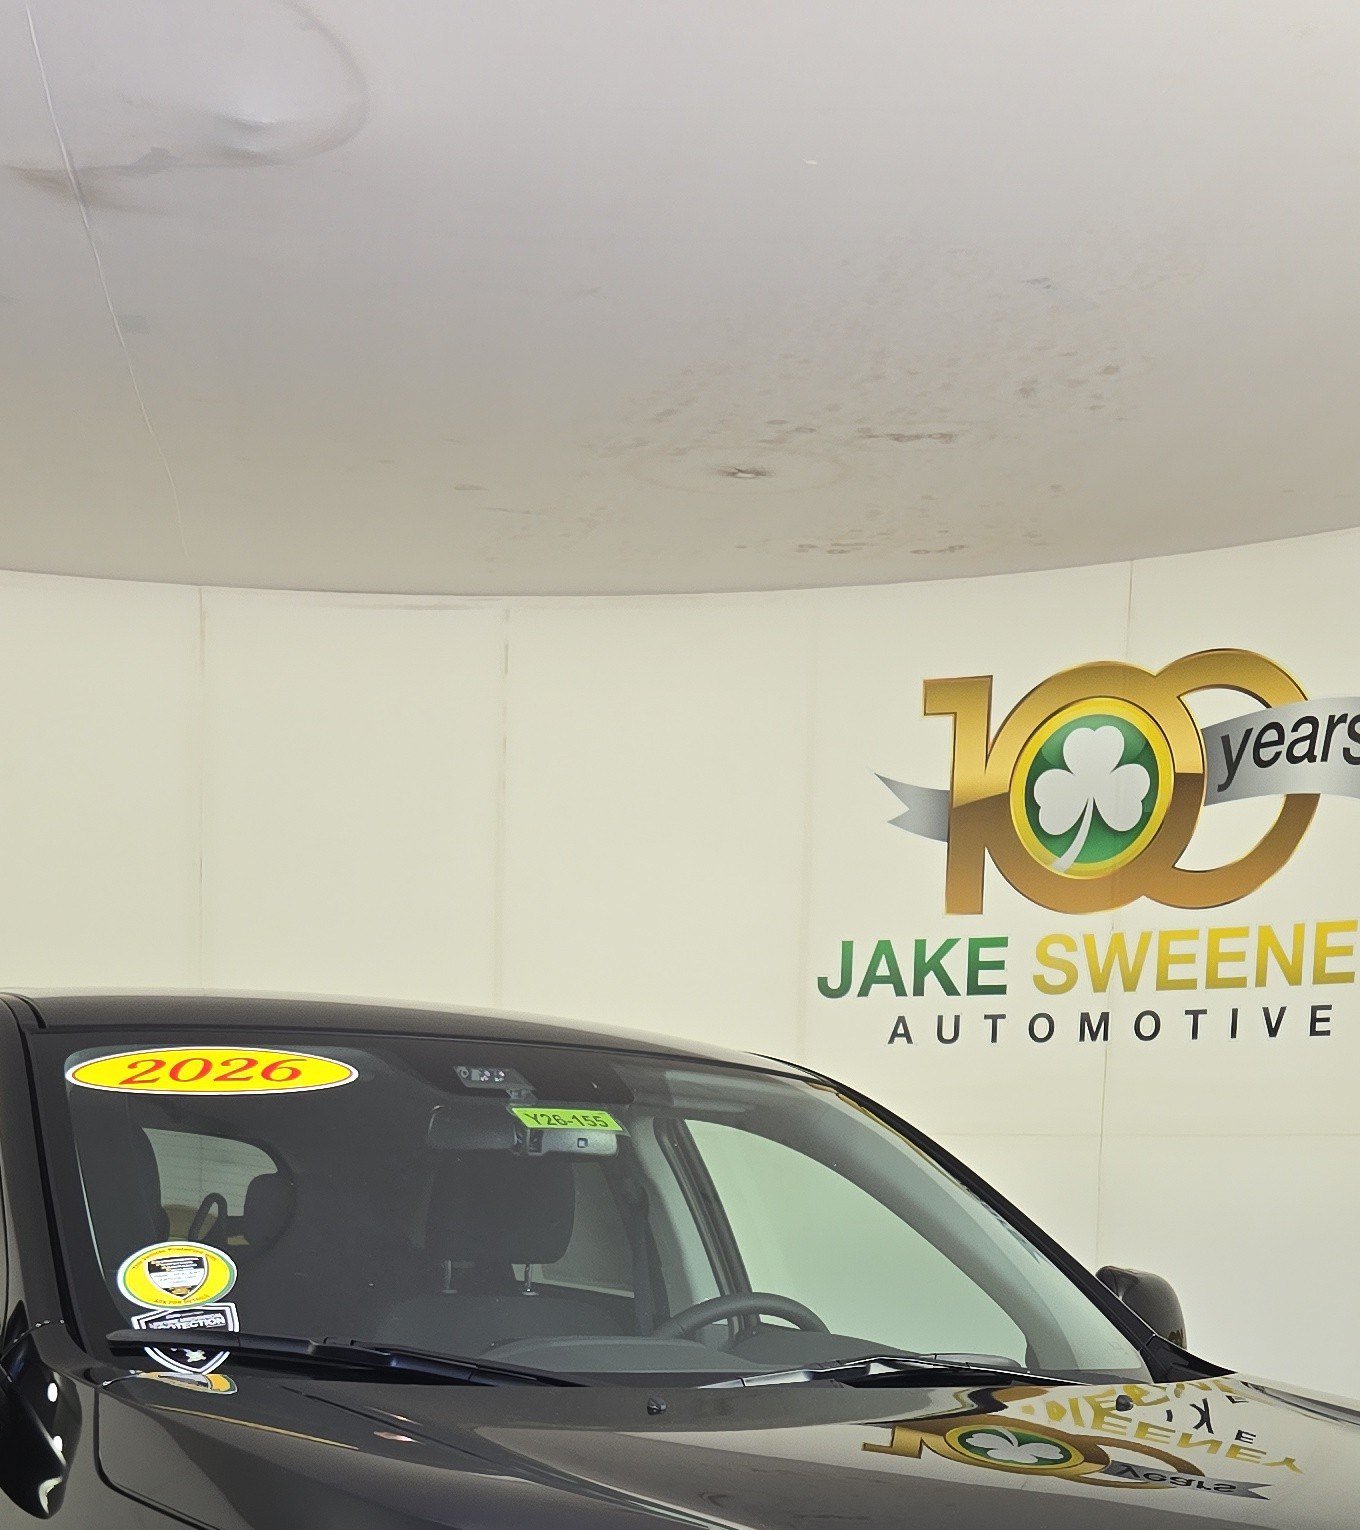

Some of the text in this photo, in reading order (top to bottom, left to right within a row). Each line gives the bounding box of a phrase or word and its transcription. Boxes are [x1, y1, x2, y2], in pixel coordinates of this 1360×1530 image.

[923, 648, 1320, 915] 100
[817, 936, 1009, 999] JAKE
[888, 1004, 1334, 1045] AUTOMOTIVE
[119, 1057, 308, 1084] 2026
